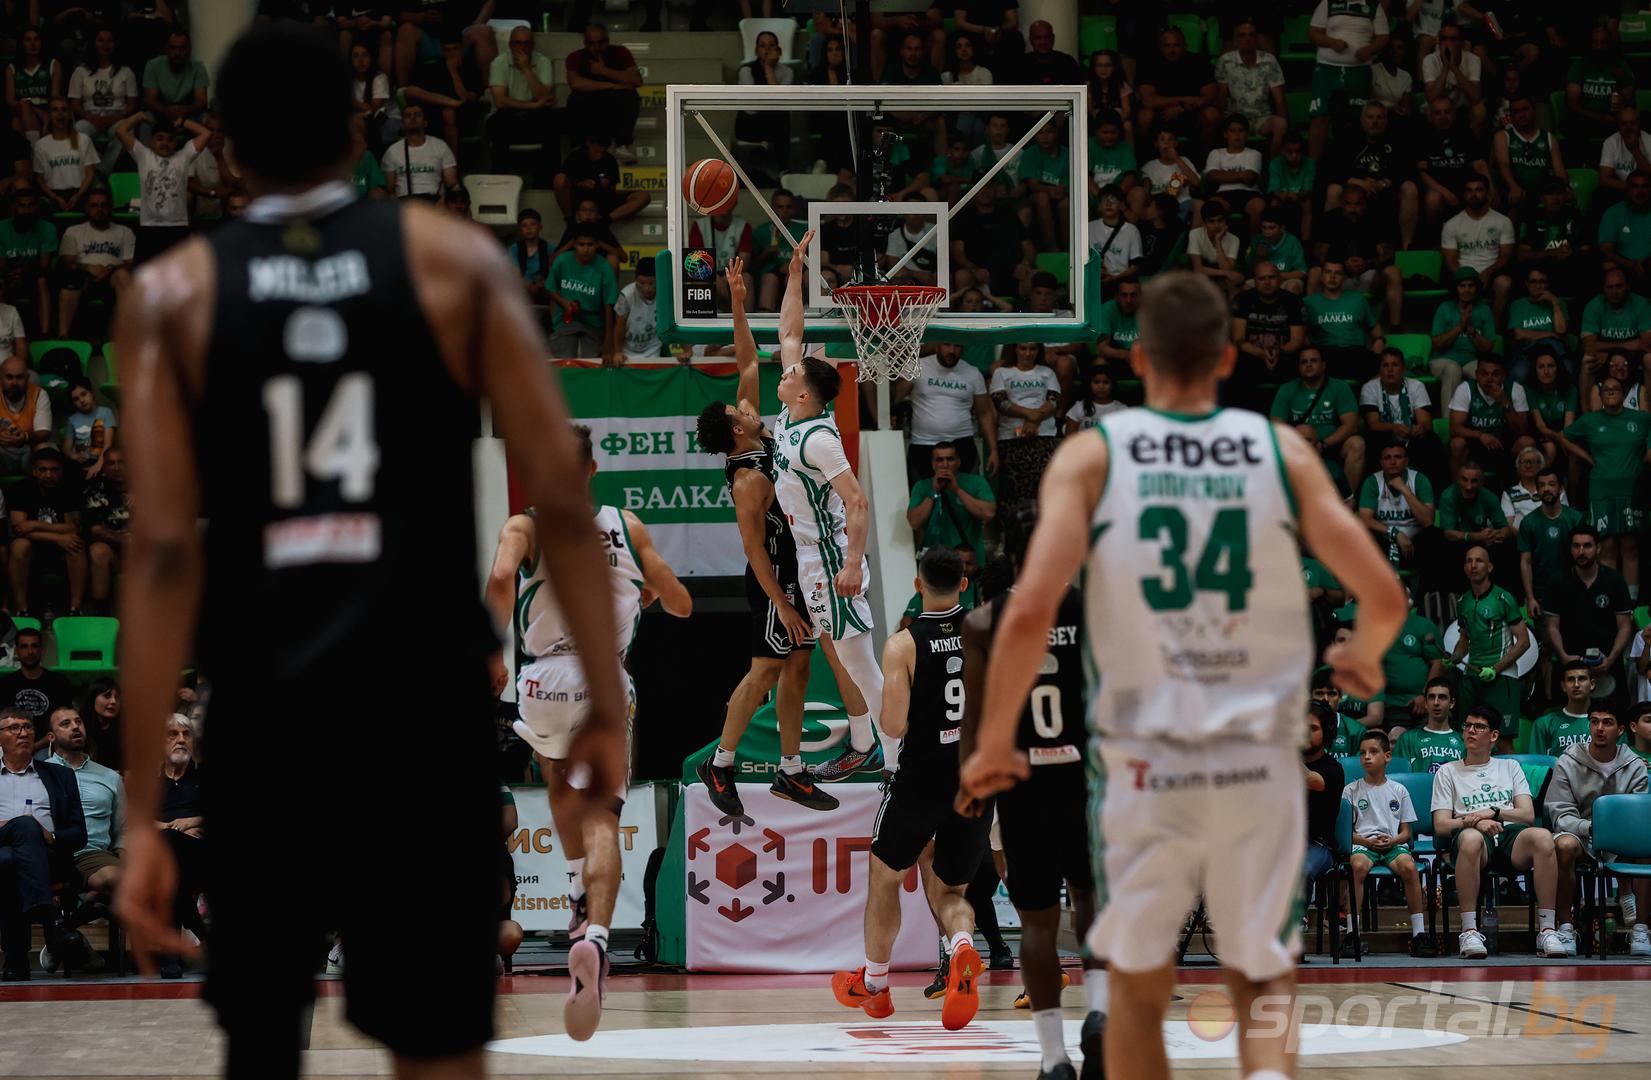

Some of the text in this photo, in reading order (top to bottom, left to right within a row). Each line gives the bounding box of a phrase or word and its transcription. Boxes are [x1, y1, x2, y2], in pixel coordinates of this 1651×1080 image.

[1583, 85, 1615, 97] BALKA
[561, 279, 596, 296] БАЛКАН
[687, 288, 712, 301] FIBA
[1317, 313, 1353, 325] БАЛКАН
[1523, 315, 1553, 329] БАЛКА
[927, 377, 967, 391] БАЛКАН
[1010, 380, 1047, 391] БАЛКАН
[262, 371, 381, 508] 14
[601, 432, 675, 455] ФЕН
[1130, 433, 1263, 468] efbet
[1379, 508, 1412, 522] BALKA
[1139, 505, 1253, 612] 34
[944, 678, 966, 721] 9
[1031, 685, 1063, 739] 0
[1420, 746, 1462, 760] BALKAN
[1462, 790, 1513, 807] BALKAN
